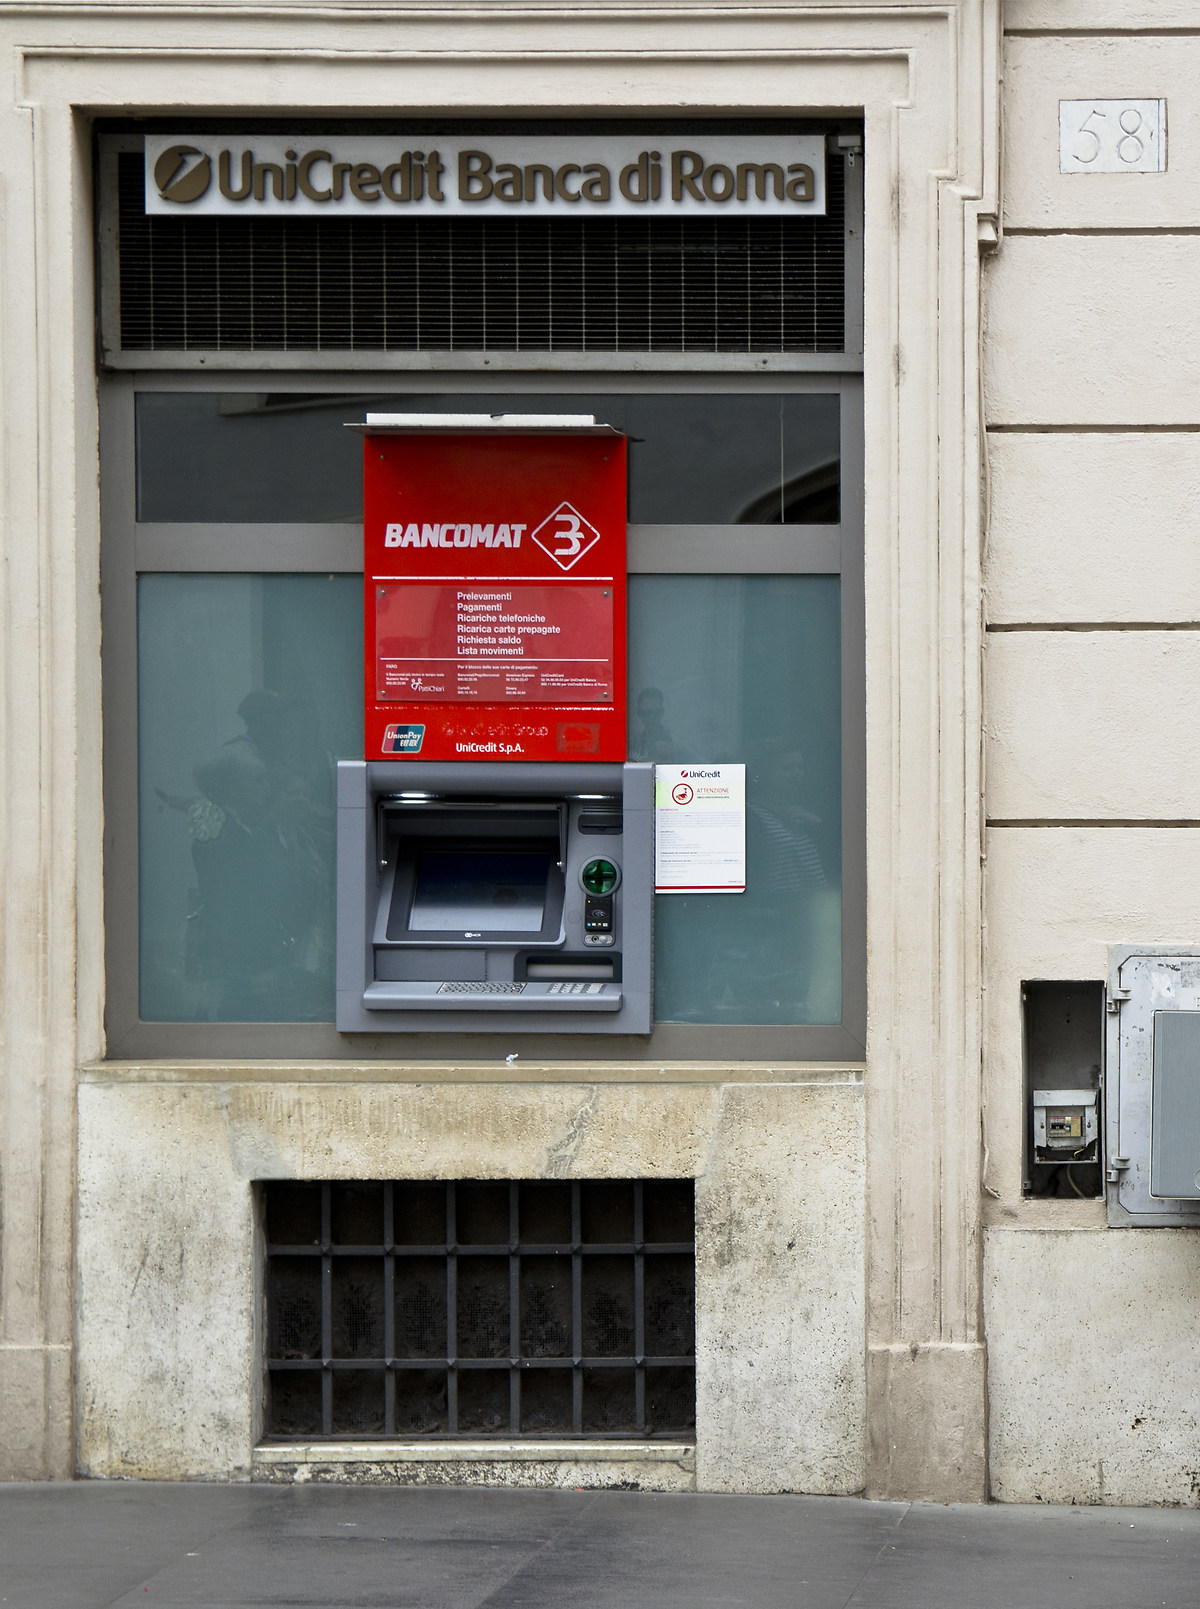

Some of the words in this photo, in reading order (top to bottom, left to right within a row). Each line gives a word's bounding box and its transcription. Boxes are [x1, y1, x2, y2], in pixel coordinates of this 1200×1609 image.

[1072, 108, 1144, 163] 58
[218, 149, 445, 203] UniCredit
[457, 150, 611, 203] Banca
[618, 149, 660, 203] di
[672, 150, 815, 202] Roma
[384, 523, 527, 548] BANCOMAT
[457, 592, 512, 601] Prelevamenti
[457, 603, 502, 613] Pagamenti
[457, 614, 497, 623] Ricariche
[499, 614, 546, 623] telefoniche
[457, 625, 492, 634] Ricarica
[493, 626, 516, 634] carte
[517, 626, 561, 636] prepagate
[457, 636, 496, 644] Richiesta
[498, 636, 522, 644] saldo
[457, 646, 478, 655] Lista
[479, 646, 524, 655] movimenti
[387, 731, 421, 742] UnionPay
[456, 742, 497, 752] UniCredit
[499, 743, 525, 755] S.p.A.
[689, 770, 720, 778] UniCredit
